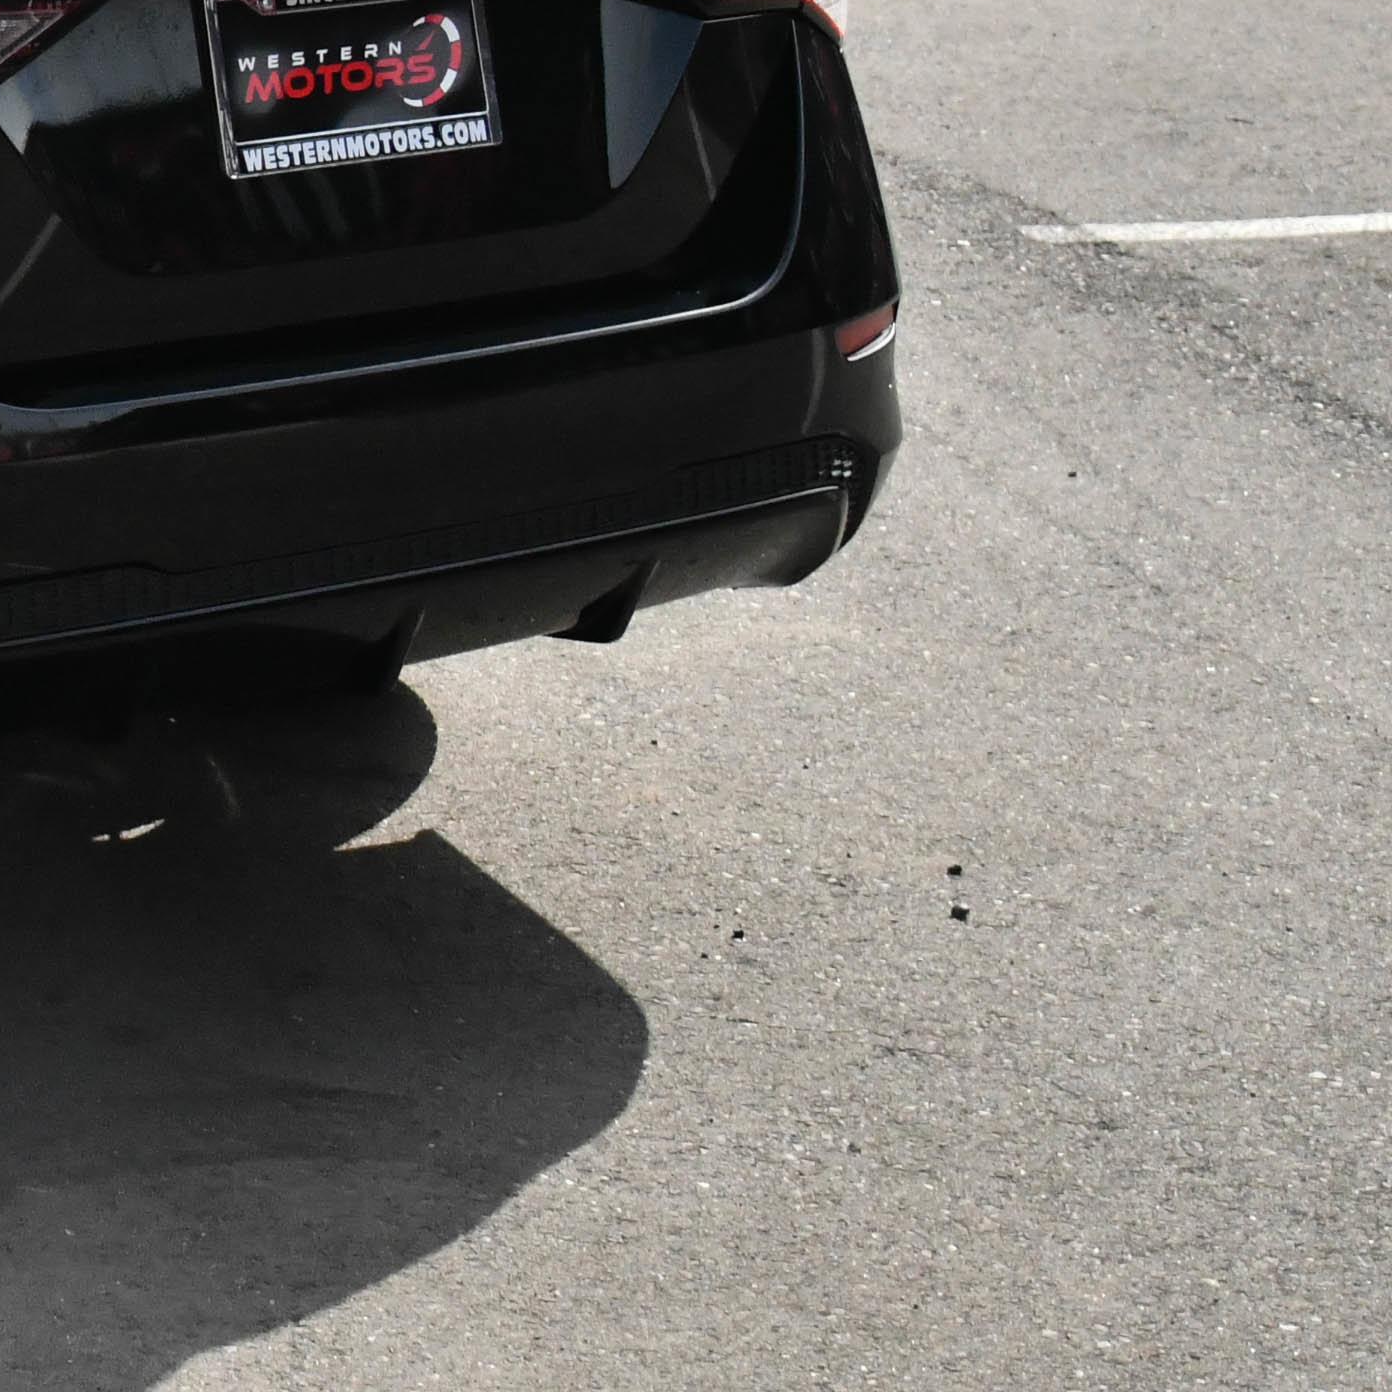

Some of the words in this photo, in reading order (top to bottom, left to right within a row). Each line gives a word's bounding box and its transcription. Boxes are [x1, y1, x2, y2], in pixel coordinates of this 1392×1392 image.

[237, 40, 403, 73] WESTERN
[244, 53, 437, 104] MOTORS
[242, 119, 488, 173] WESTERNMOTORS.COM
